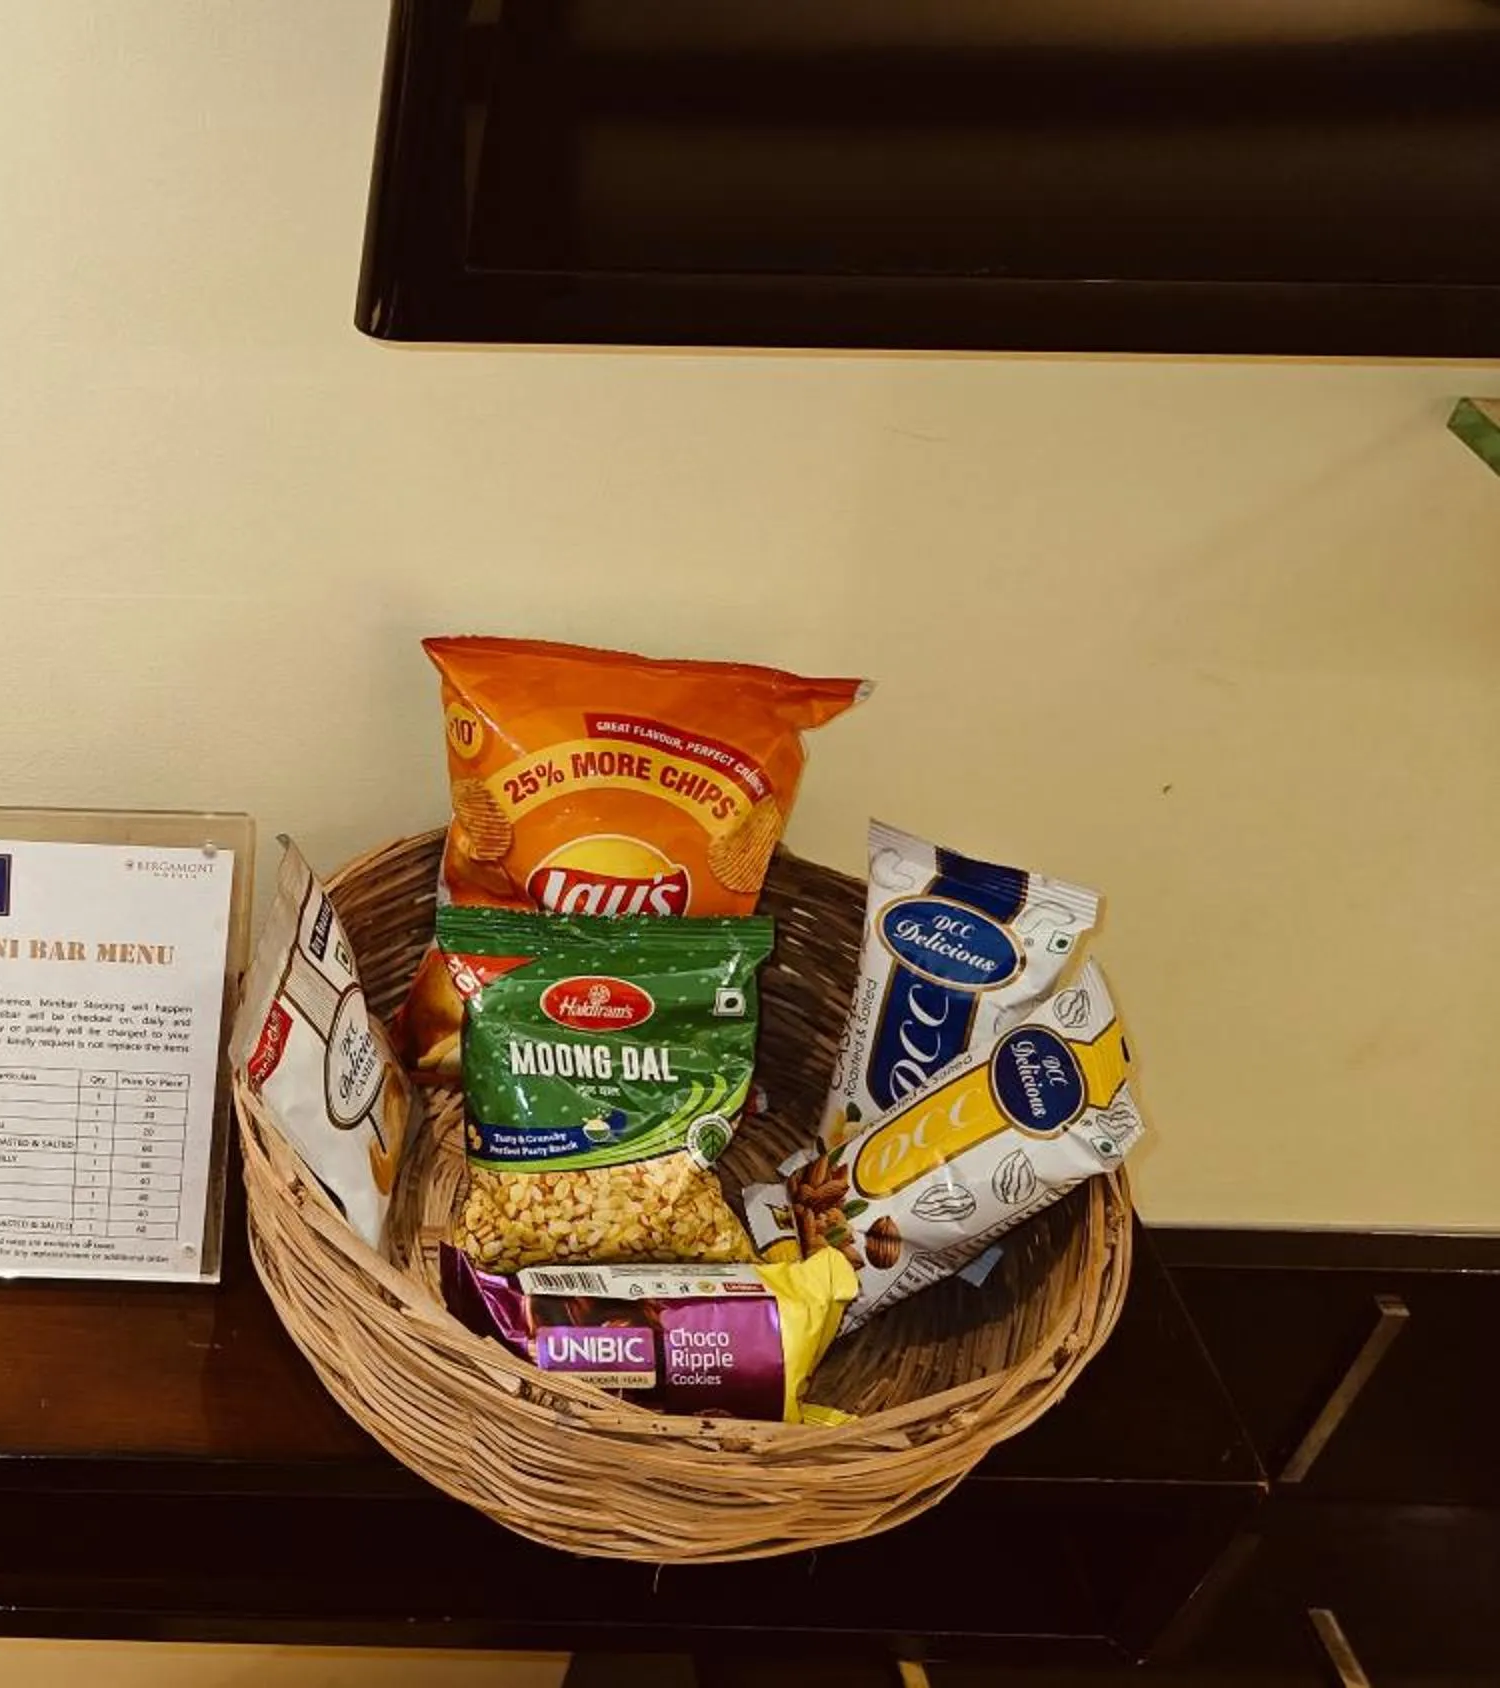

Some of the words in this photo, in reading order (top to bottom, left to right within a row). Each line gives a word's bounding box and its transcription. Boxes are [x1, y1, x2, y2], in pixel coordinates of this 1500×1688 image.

[596, 721, 631, 733] GREAT
[633, 725, 684, 750] FLAVOUR,
[686, 741, 736, 767] PERFECT
[503, 760, 565, 804] 25%
[571, 751, 652, 781] MORE
[932, 914, 977, 939] DCC
[29, 940, 86, 961] BAR
[97, 943, 175, 965] MENU
[893, 919, 998, 972] Delicious
[142, 1017, 165, 1027] daily
[156, 1005, 193, 1014] happen
[108, 1029, 148, 1040] charged
[509, 1041, 612, 1079] MOONG
[622, 1046, 679, 1083] DAL
[1041, 1055, 1069, 1087] DCC
[1010, 1041, 1046, 1118] Delicious
[548, 1336, 645, 1363] UNIBIC
[670, 1328, 729, 1347] Choco
[671, 1347, 734, 1371] Ripple
[672, 1373, 722, 1386] Cookies
